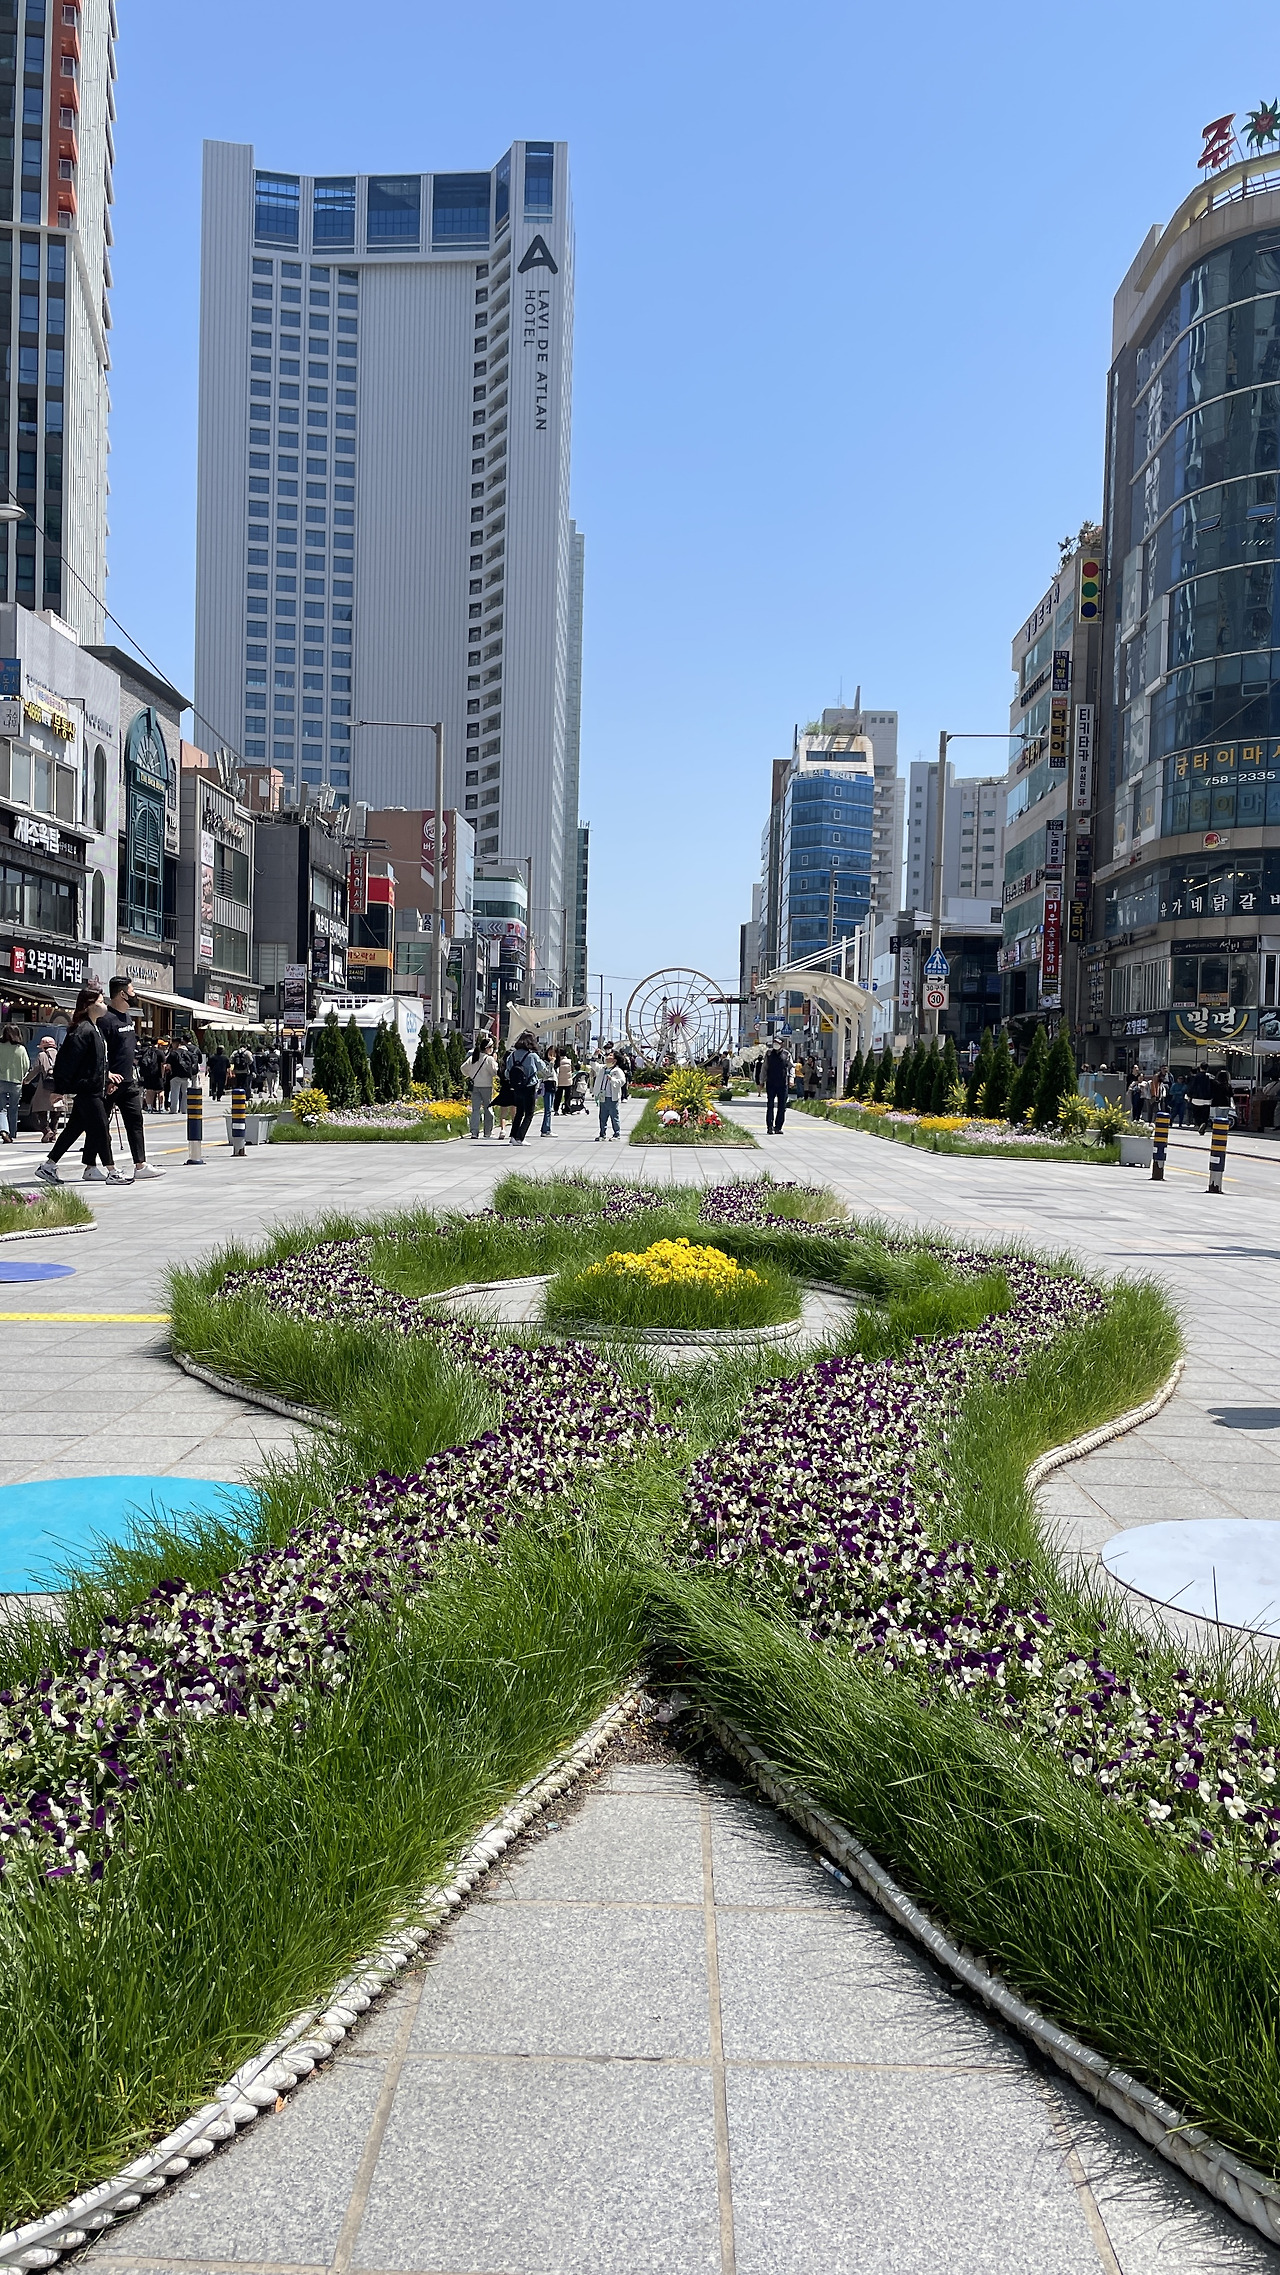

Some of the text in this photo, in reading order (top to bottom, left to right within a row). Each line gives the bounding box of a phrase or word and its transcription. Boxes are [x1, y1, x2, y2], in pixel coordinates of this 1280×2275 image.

[523, 290, 535, 347] HOTEL
[535, 290, 549, 430] LAVI DE ATLAN
[6, 708, 18, 719] 국수
[53, 713, 77, 743] 부동산
[1051, 709, 1066, 754] 더타이
[1078, 709, 1090, 761] 티키타카
[1205, 771, 1276, 786] 758-2335
[1077, 799, 1087, 807] 5F
[14, 815, 61, 854] 제주옥탑
[353, 858, 364, 910] 타이마사지
[424, 914, 432, 931] BAR
[1072, 902, 1085, 940] 궁타이
[1220, 939, 1240, 953] 설빙
[27, 948, 83, 984] 오복돼지국밥
[930, 995, 941, 1004] 30
[1187, 1007, 1236, 1034] 밀면
